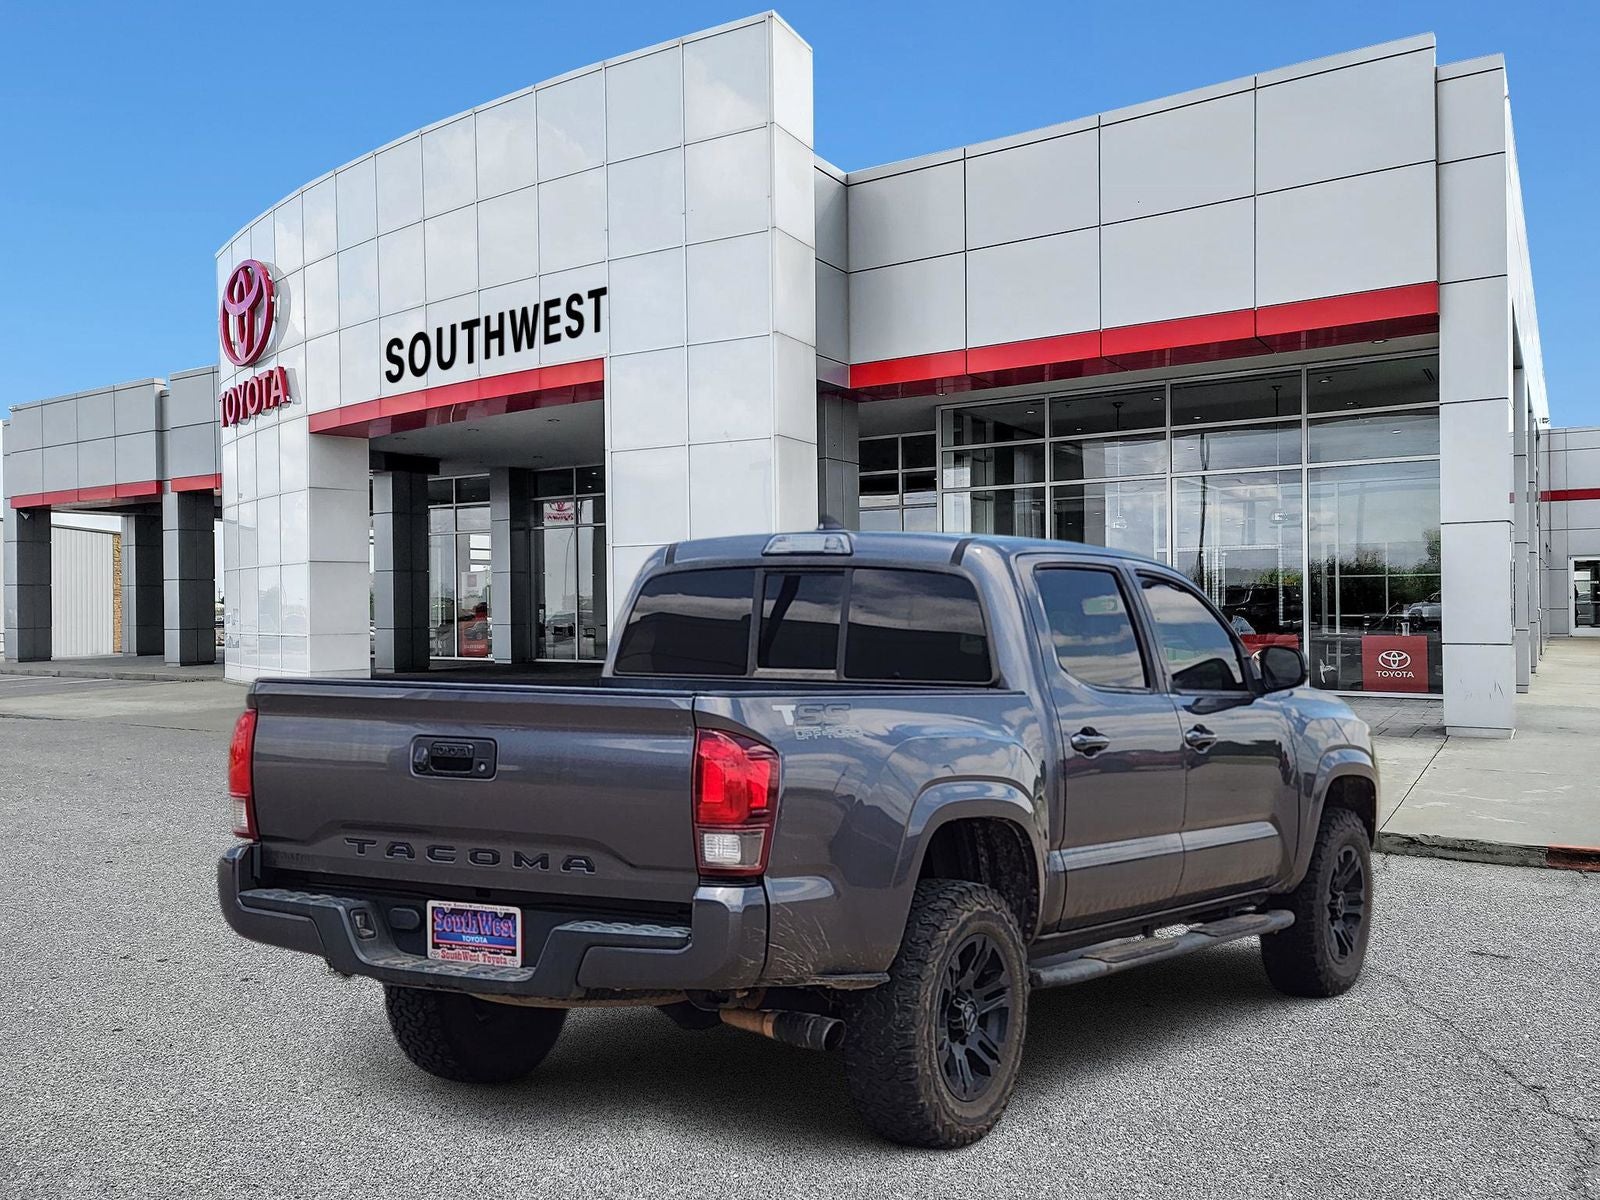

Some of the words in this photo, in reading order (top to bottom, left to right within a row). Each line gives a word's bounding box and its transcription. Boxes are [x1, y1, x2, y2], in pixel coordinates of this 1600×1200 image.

[385, 286, 608, 384] SOUTHWEST
[219, 366, 292, 428] TOYOTA
[1376, 670, 1415, 678] TOYOTA
[771, 703, 852, 727] TSS
[343, 837, 596, 875] TACOMA
[462, 935, 489, 944] TOYOTA
[481, 951, 508, 966] Toyota
